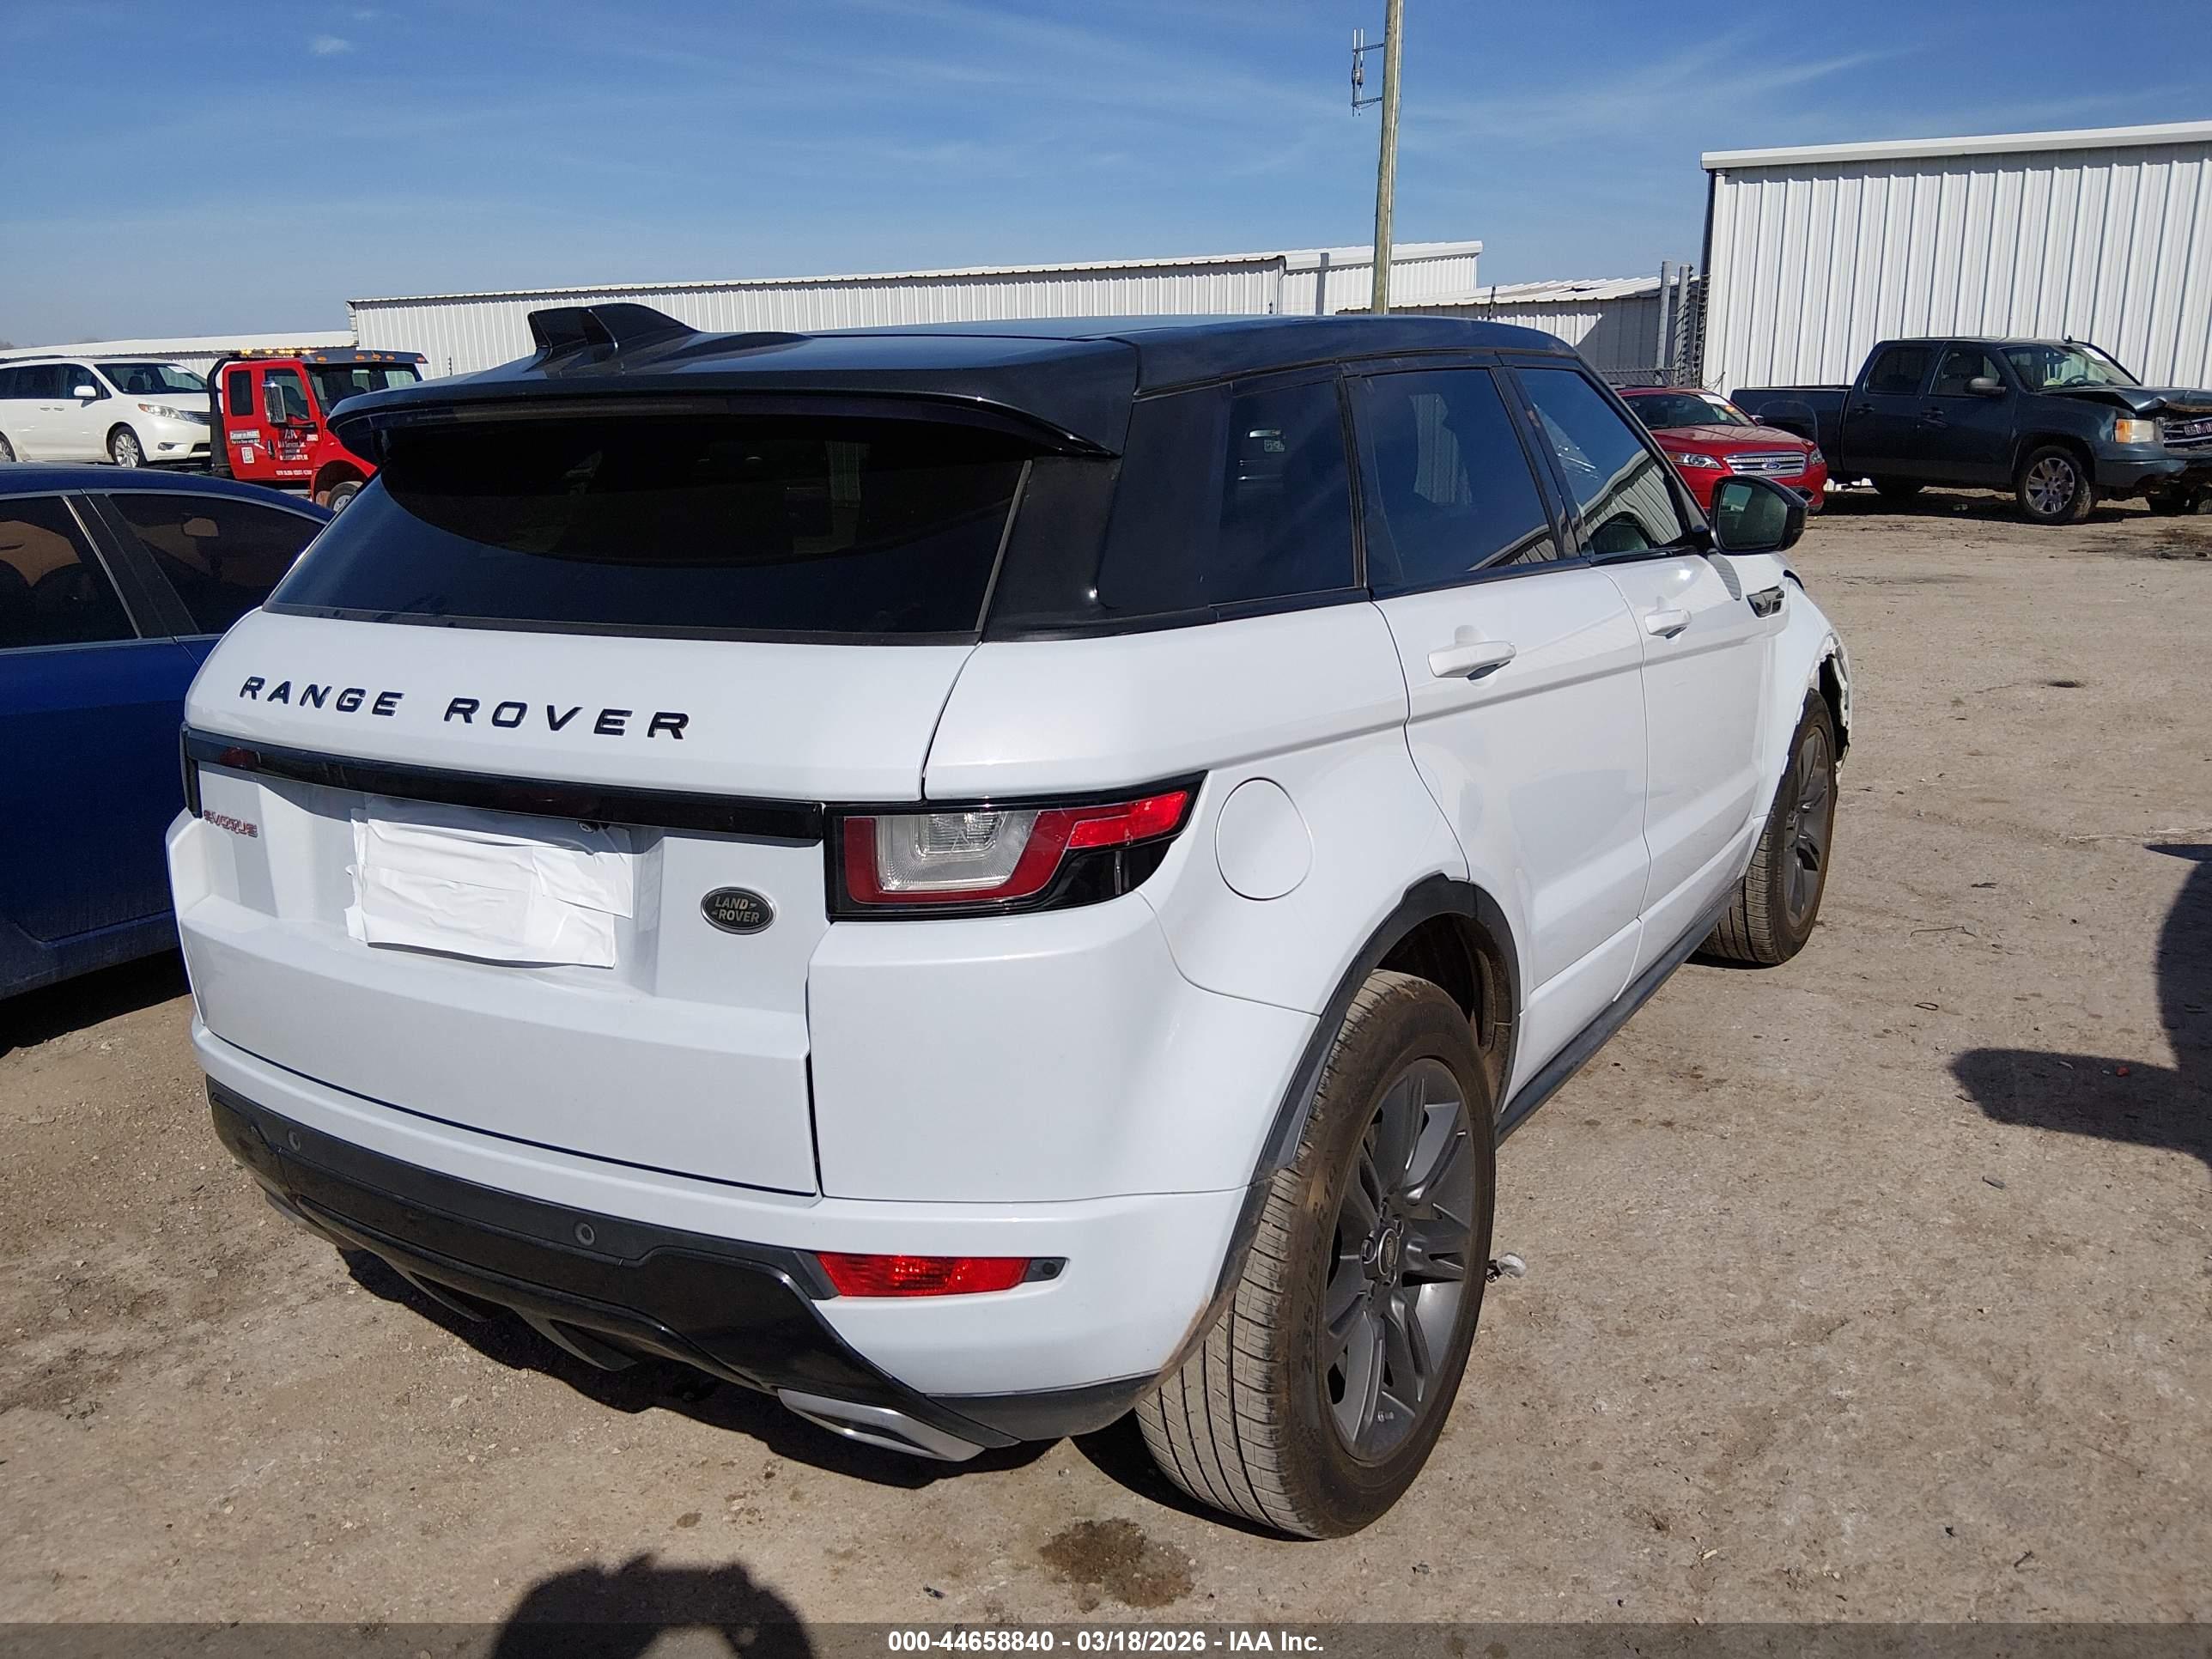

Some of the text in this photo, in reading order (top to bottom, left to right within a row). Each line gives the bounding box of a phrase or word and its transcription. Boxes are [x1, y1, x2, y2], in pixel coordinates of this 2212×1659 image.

[240, 676, 690, 740] RANGE ROVER
[714, 896, 750, 910] LAND
[718, 908, 760, 923] ROVER
